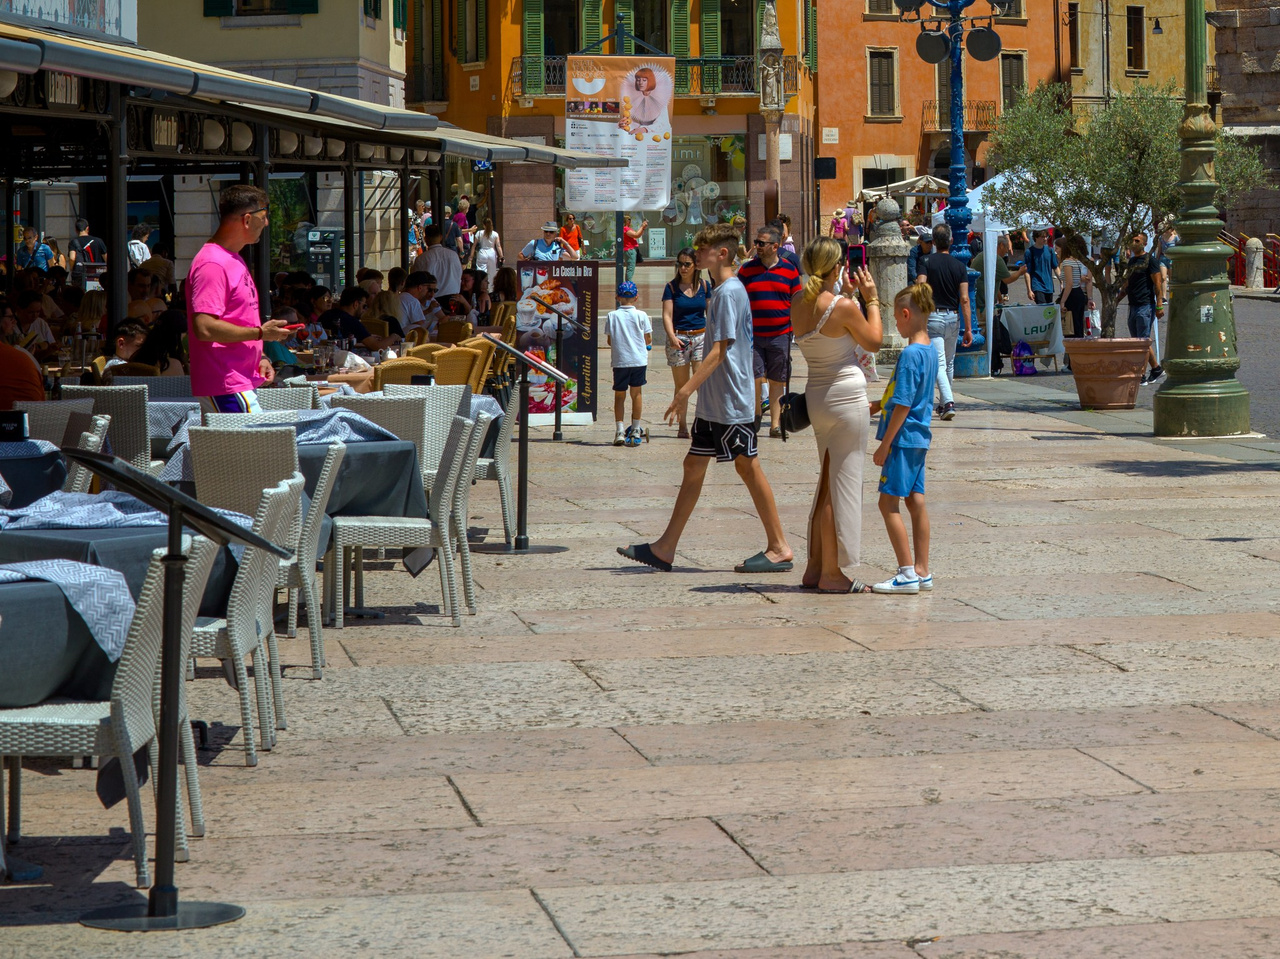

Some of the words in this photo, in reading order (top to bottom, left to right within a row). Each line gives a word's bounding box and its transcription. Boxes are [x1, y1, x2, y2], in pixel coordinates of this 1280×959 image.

[552, 265, 560, 277] La
[560, 265, 576, 277] Costa
[583, 265, 593, 277] Bra
[581, 355, 592, 405] Aperitivi
